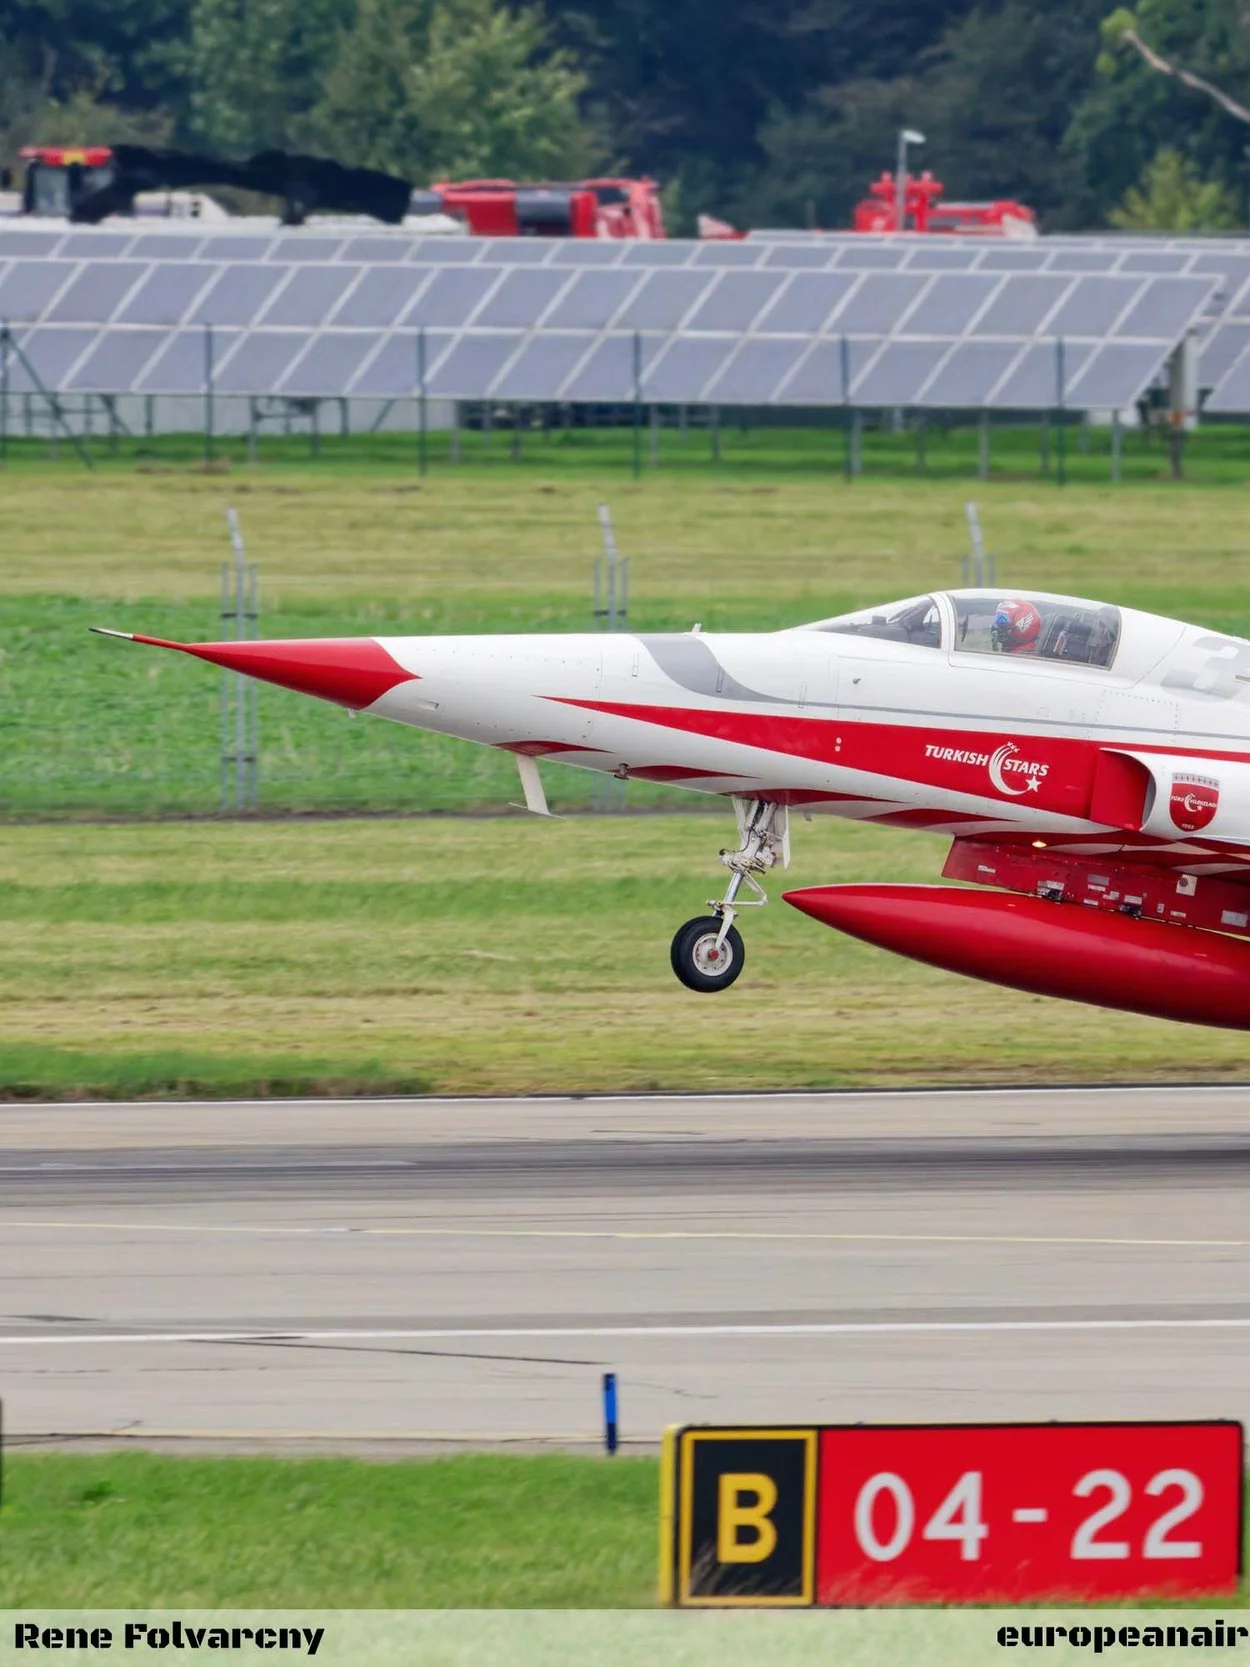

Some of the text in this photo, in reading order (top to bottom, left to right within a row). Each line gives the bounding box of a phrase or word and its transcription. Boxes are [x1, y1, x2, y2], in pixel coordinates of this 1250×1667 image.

[925, 744, 1050, 777] TURKISH STARS
[716, 1473, 778, 1564] B
